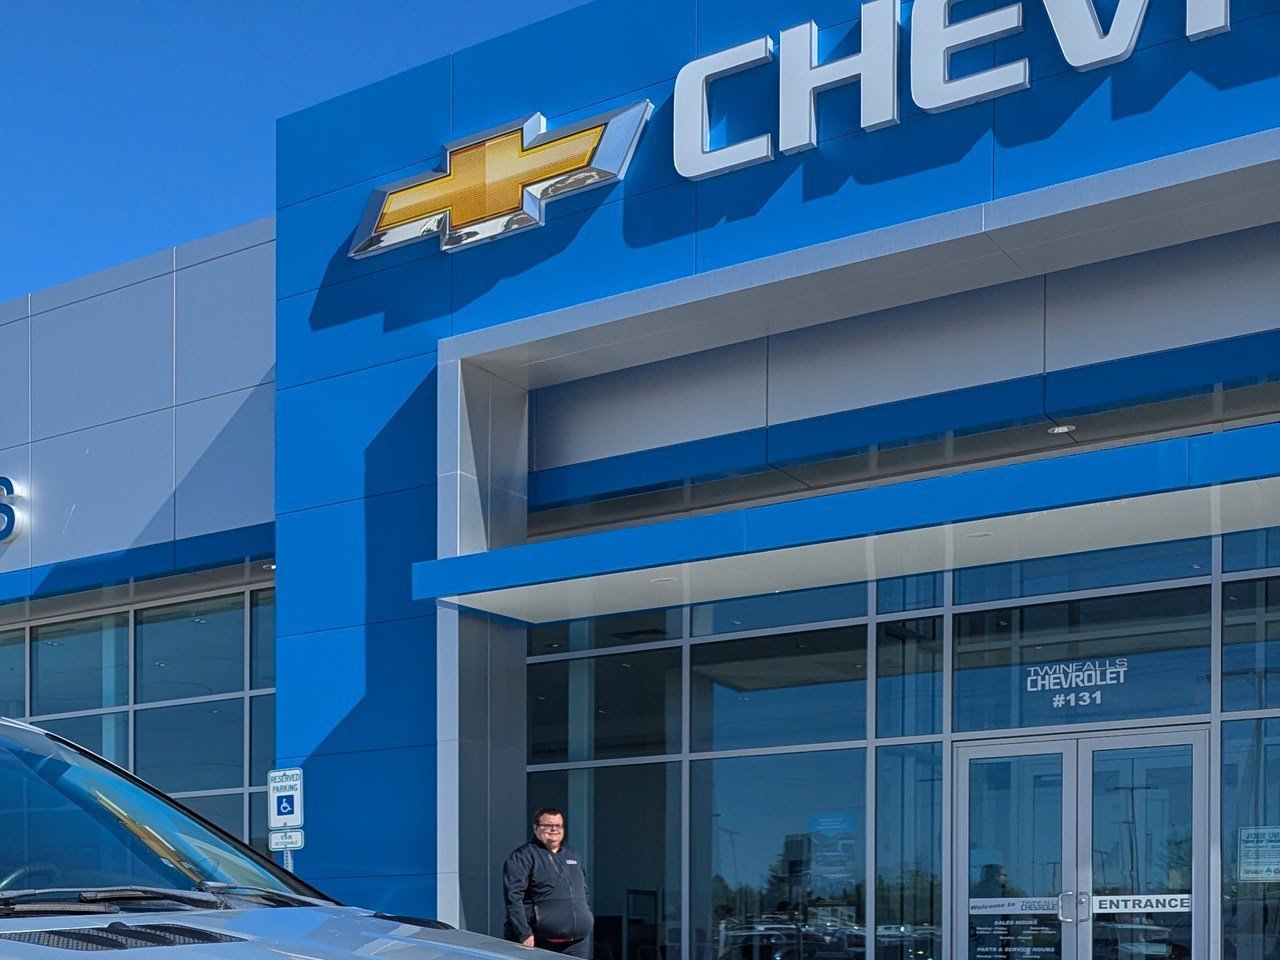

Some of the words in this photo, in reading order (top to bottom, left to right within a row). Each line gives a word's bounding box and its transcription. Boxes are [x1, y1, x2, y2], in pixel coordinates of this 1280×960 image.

[673, 0, 1232, 181] CHEV
[1027, 658, 1128, 677] TWINFALLS
[1026, 667, 1128, 692] CHEVROLET
[1052, 690, 1102, 709] #131
[270, 773, 300, 784] RESERVED
[272, 783, 299, 794] PARKING
[970, 903, 1006, 911] Welcome
[1098, 897, 1190, 910] ENTRANCE
